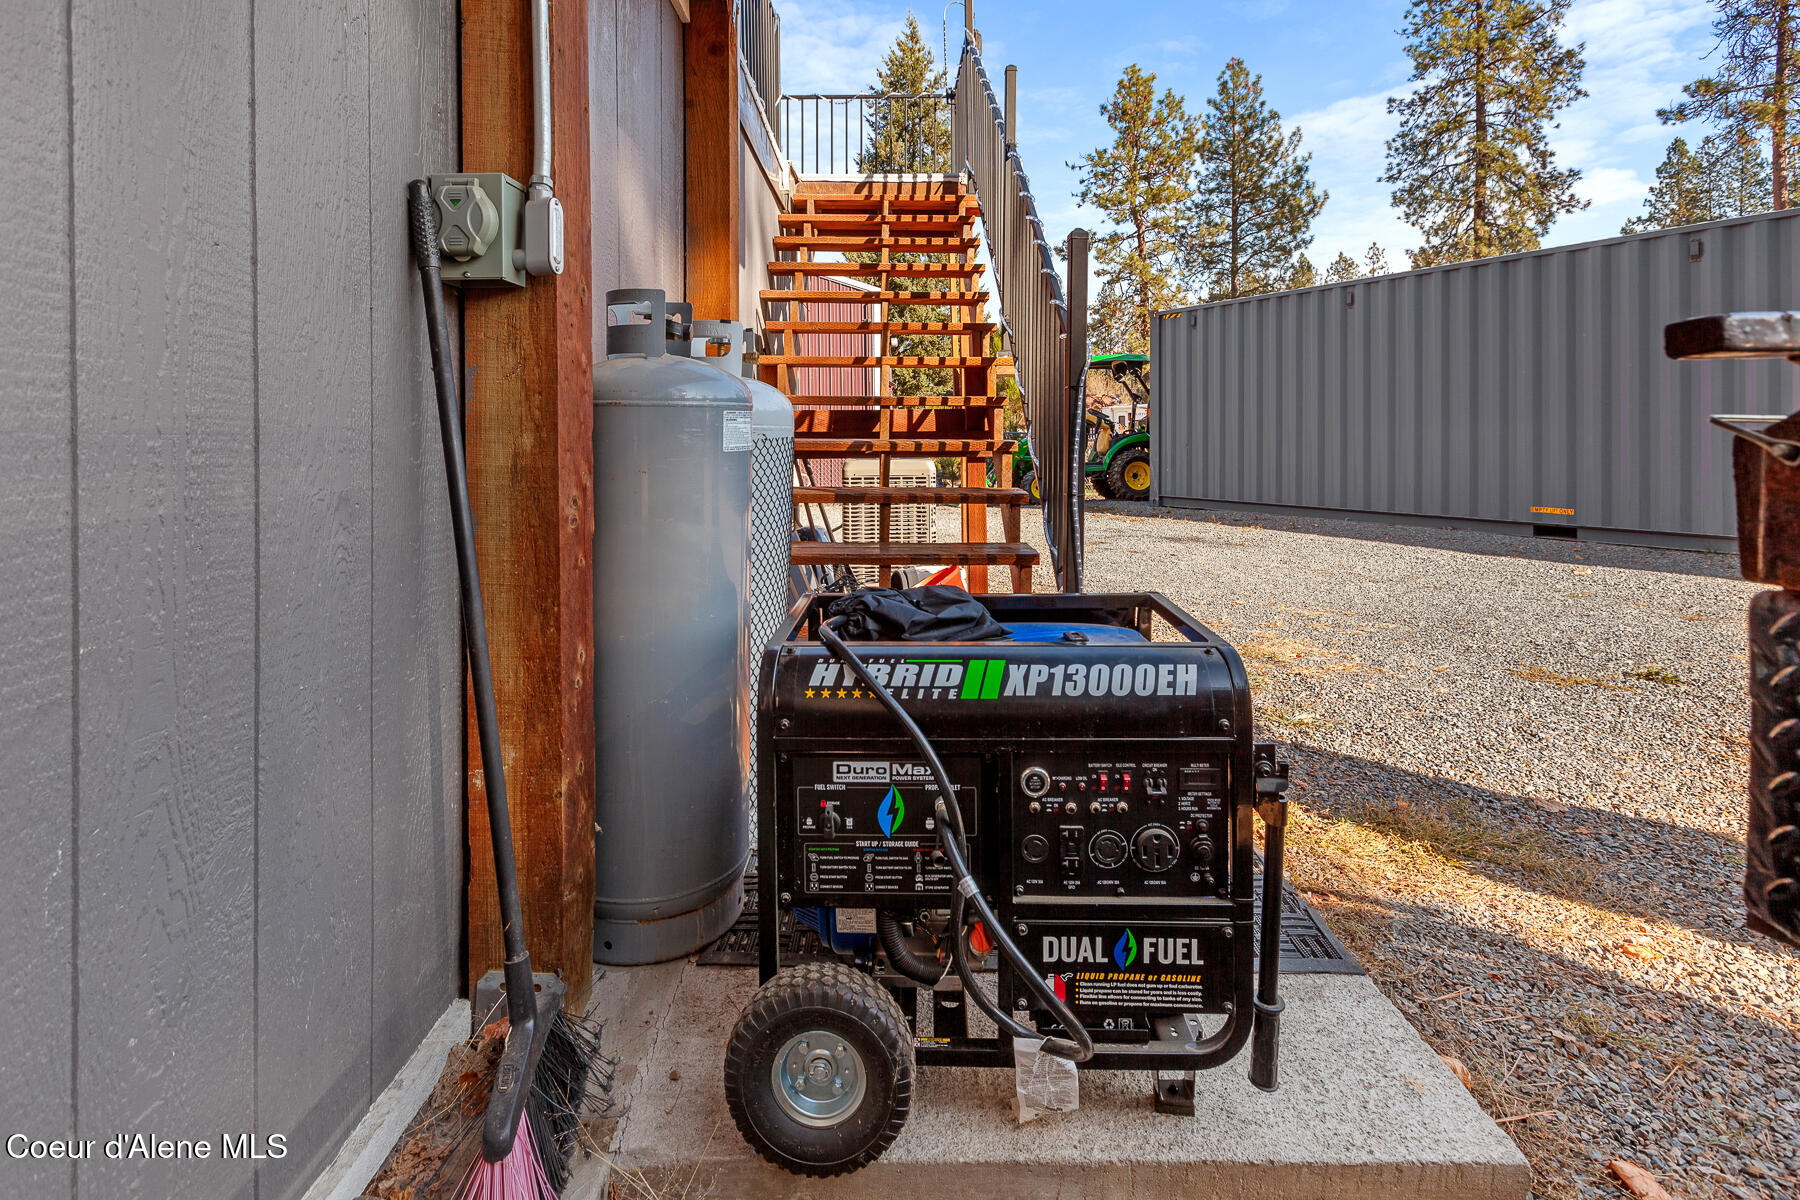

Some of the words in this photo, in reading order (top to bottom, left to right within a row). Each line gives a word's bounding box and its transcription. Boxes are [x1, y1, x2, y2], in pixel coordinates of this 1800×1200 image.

[1003, 664, 1198, 696] XP13000EH
[836, 764, 887, 775] Duro
[1043, 936, 1108, 963] DUAL
[1144, 938, 1204, 965] FUEL
[1076, 972, 1105, 980] LIQUID
[1161, 974, 1202, 982] GASOLINE
